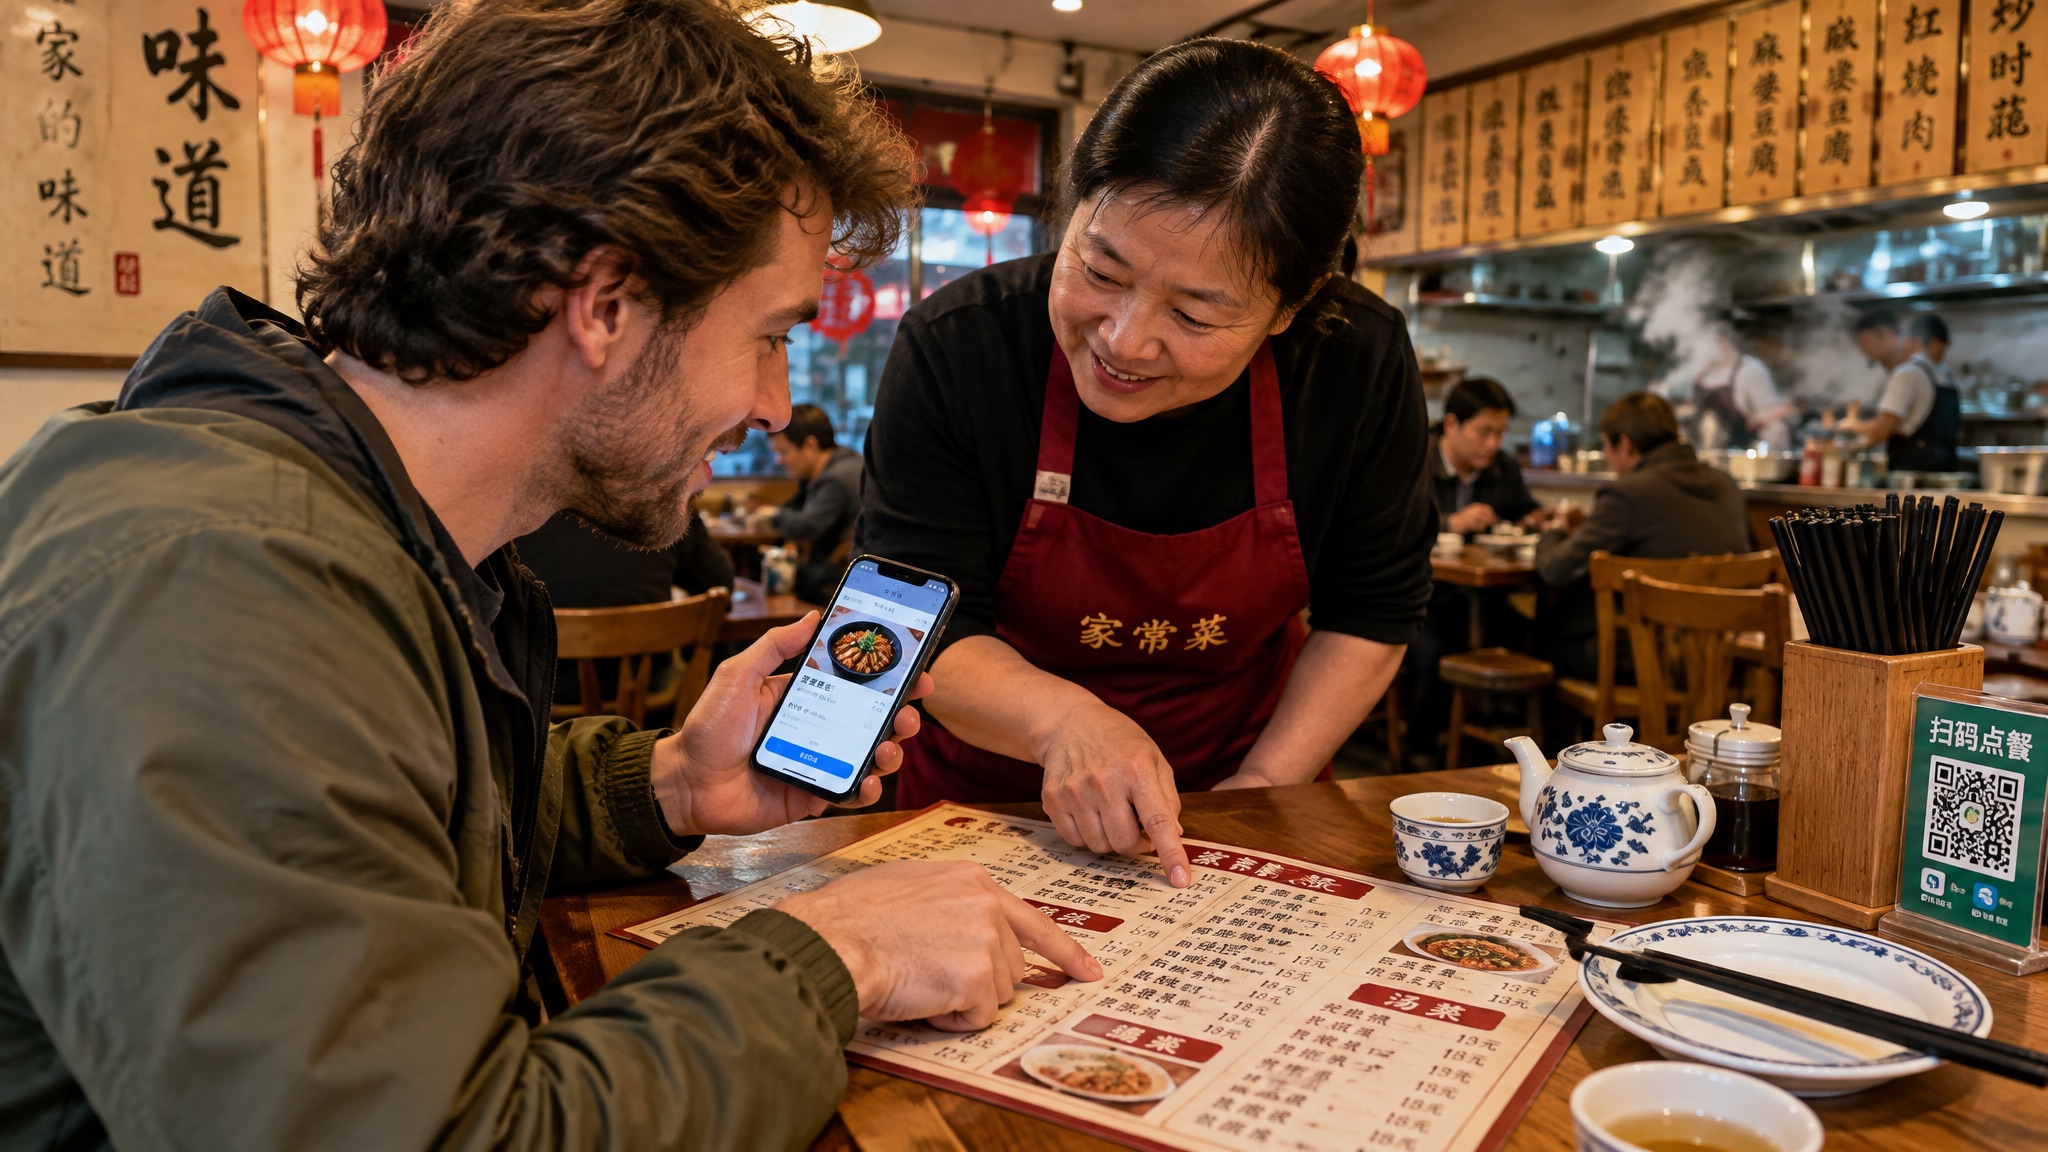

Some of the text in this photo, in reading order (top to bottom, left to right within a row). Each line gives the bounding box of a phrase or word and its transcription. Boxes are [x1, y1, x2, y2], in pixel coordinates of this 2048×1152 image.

[36, 0, 92, 297] 家的味道
[142, 7, 241, 249] 味道
[1079, 612, 1228, 654] 家常菜
[1929, 715, 2033, 763] 扫码点餐
[1488, 994, 1530, 1010] 13元
[1501, 982, 1540, 998] 13元
